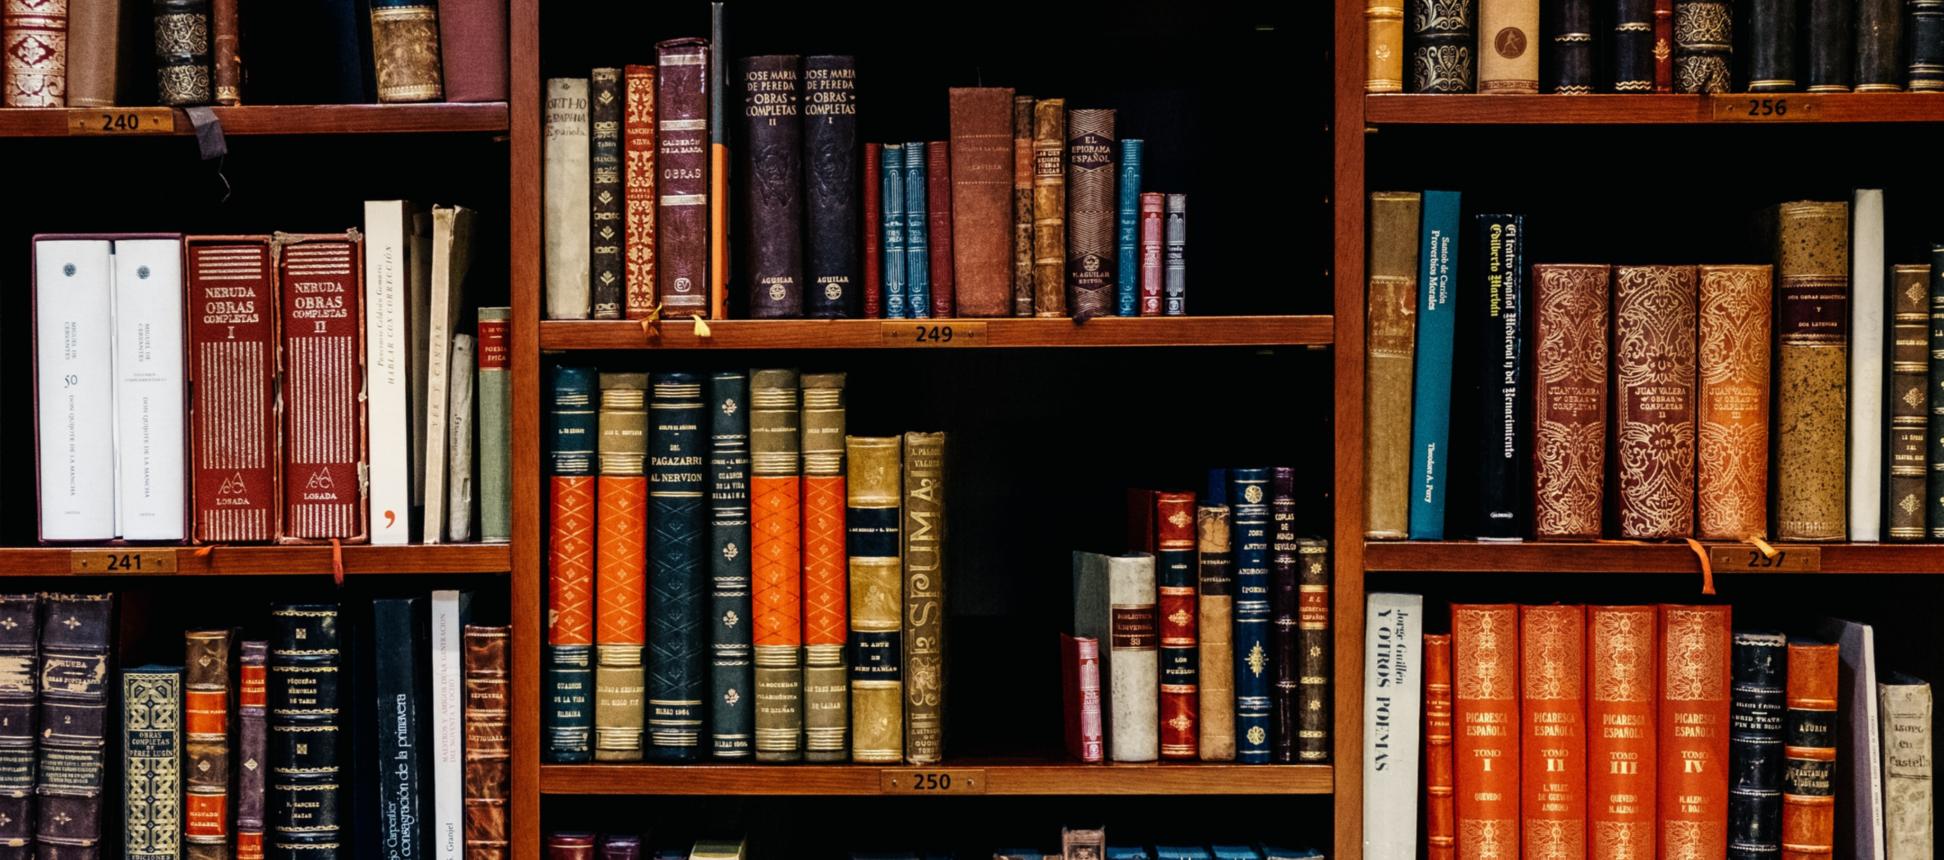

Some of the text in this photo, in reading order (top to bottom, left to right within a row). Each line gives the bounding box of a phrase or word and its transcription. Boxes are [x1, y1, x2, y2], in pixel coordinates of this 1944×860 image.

[746, 70, 796, 80] JOSE MARIA
[805, 69, 856, 79] JOSE MARIA
[747, 81, 794, 91] DE PEREDA
[807, 80, 854, 90] DE PEREDA
[754, 93, 787, 104] OBRAS
[813, 92, 846, 103] OBRAS
[746, 105, 797, 116] COMPLETAS
[805, 104, 856, 115] COMPLETAS
[1748, 100, 1786, 116] 256
[102, 114, 139, 131] 240
[1085, 136, 1097, 144] EL
[1072, 145, 1111, 154] EPIGRAMA
[1072, 152, 1110, 163] ESPAÑOL
[664, 168, 701, 179] OBRAS
[1505, 224, 1517, 237] El
[1490, 224, 1502, 272] Edilberto
[1505, 239, 1516, 269] teatro
[1428, 229, 1441, 311] Proverbios Morales
[1439, 236, 1450, 304] Santob de Carrión
[761, 276, 793, 284] AGUILAR
[205, 286, 255, 298] NERUDA
[294, 282, 344, 294] NERUDA
[1503, 271, 1516, 309] español
[205, 301, 255, 314] OBRAS
[295, 296, 343, 309] OBRAS
[203, 313, 259, 324] COMPLETAS
[292, 308, 348, 319] COMPLETAS
[227, 326, 235, 339] I
[314, 321, 327, 333] II
[916, 326, 953, 342] 249
[1503, 312, 1516, 359] Medieval
[433, 324, 442, 377] CANTAR
[64, 374, 78, 388] 50
[1505, 370, 1516, 384] del
[1548, 386, 1600, 396] JUAN VALERA
[1635, 386, 1686, 396] JUAN VALERA
[1708, 386, 1762, 396] JUAN VALERA
[1563, 396, 1590, 404] OBRAS
[1552, 403, 1597, 411] COMPLETAS
[1639, 403, 1684, 412] COMPLETAS
[1713, 403, 1759, 411] COMPLETAS
[1502, 387, 1516, 458] Renacimiento
[651, 456, 703, 466] PAGAZARRI
[651, 473, 703, 482] AL NERVION
[1424, 442, 1436, 504] Theodore A. Perry
[723, 482, 731, 490] LA
[732, 482, 745, 490] VIDA
[304, 492, 337, 500] LOSADA
[1274, 513, 1295, 521] COPLAS
[1280, 523, 1289, 531] DE
[107, 554, 143, 571] 241
[1395, 609, 1408, 641] Jorge
[287, 677, 317, 685] PEQUEÑAS
[1375, 609, 1392, 772] Y OTROS POEMAS
[65, 715, 72, 724] 2
[1466, 712, 1508, 723] PICARESCA
[1534, 712, 1576, 723] PICARESCA
[1603, 714, 1645, 726] PICARESCA
[1466, 724, 1507, 736] ESPAÑOLA
[1534, 725, 1574, 737] ESPAÑOLA
[1603, 726, 1644, 738] ESPAÑOLA
[1472, 749, 1502, 757] TOMO
[1541, 749, 1569, 757] TOMO
[1609, 752, 1638, 760] TOMO
[1680, 751, 1709, 759] TOMO
[1483, 758, 1492, 772] I
[1546, 758, 1565, 772] II
[1610, 761, 1638, 775] III
[1684, 759, 1707, 773] IV
[394, 694, 414, 857] consagración de la primavera
[913, 773, 951, 790] 250
[1474, 793, 1502, 801] QUEVEDO
[386, 801, 400, 848] Carpentier
[445, 822, 455, 852] Granjel
